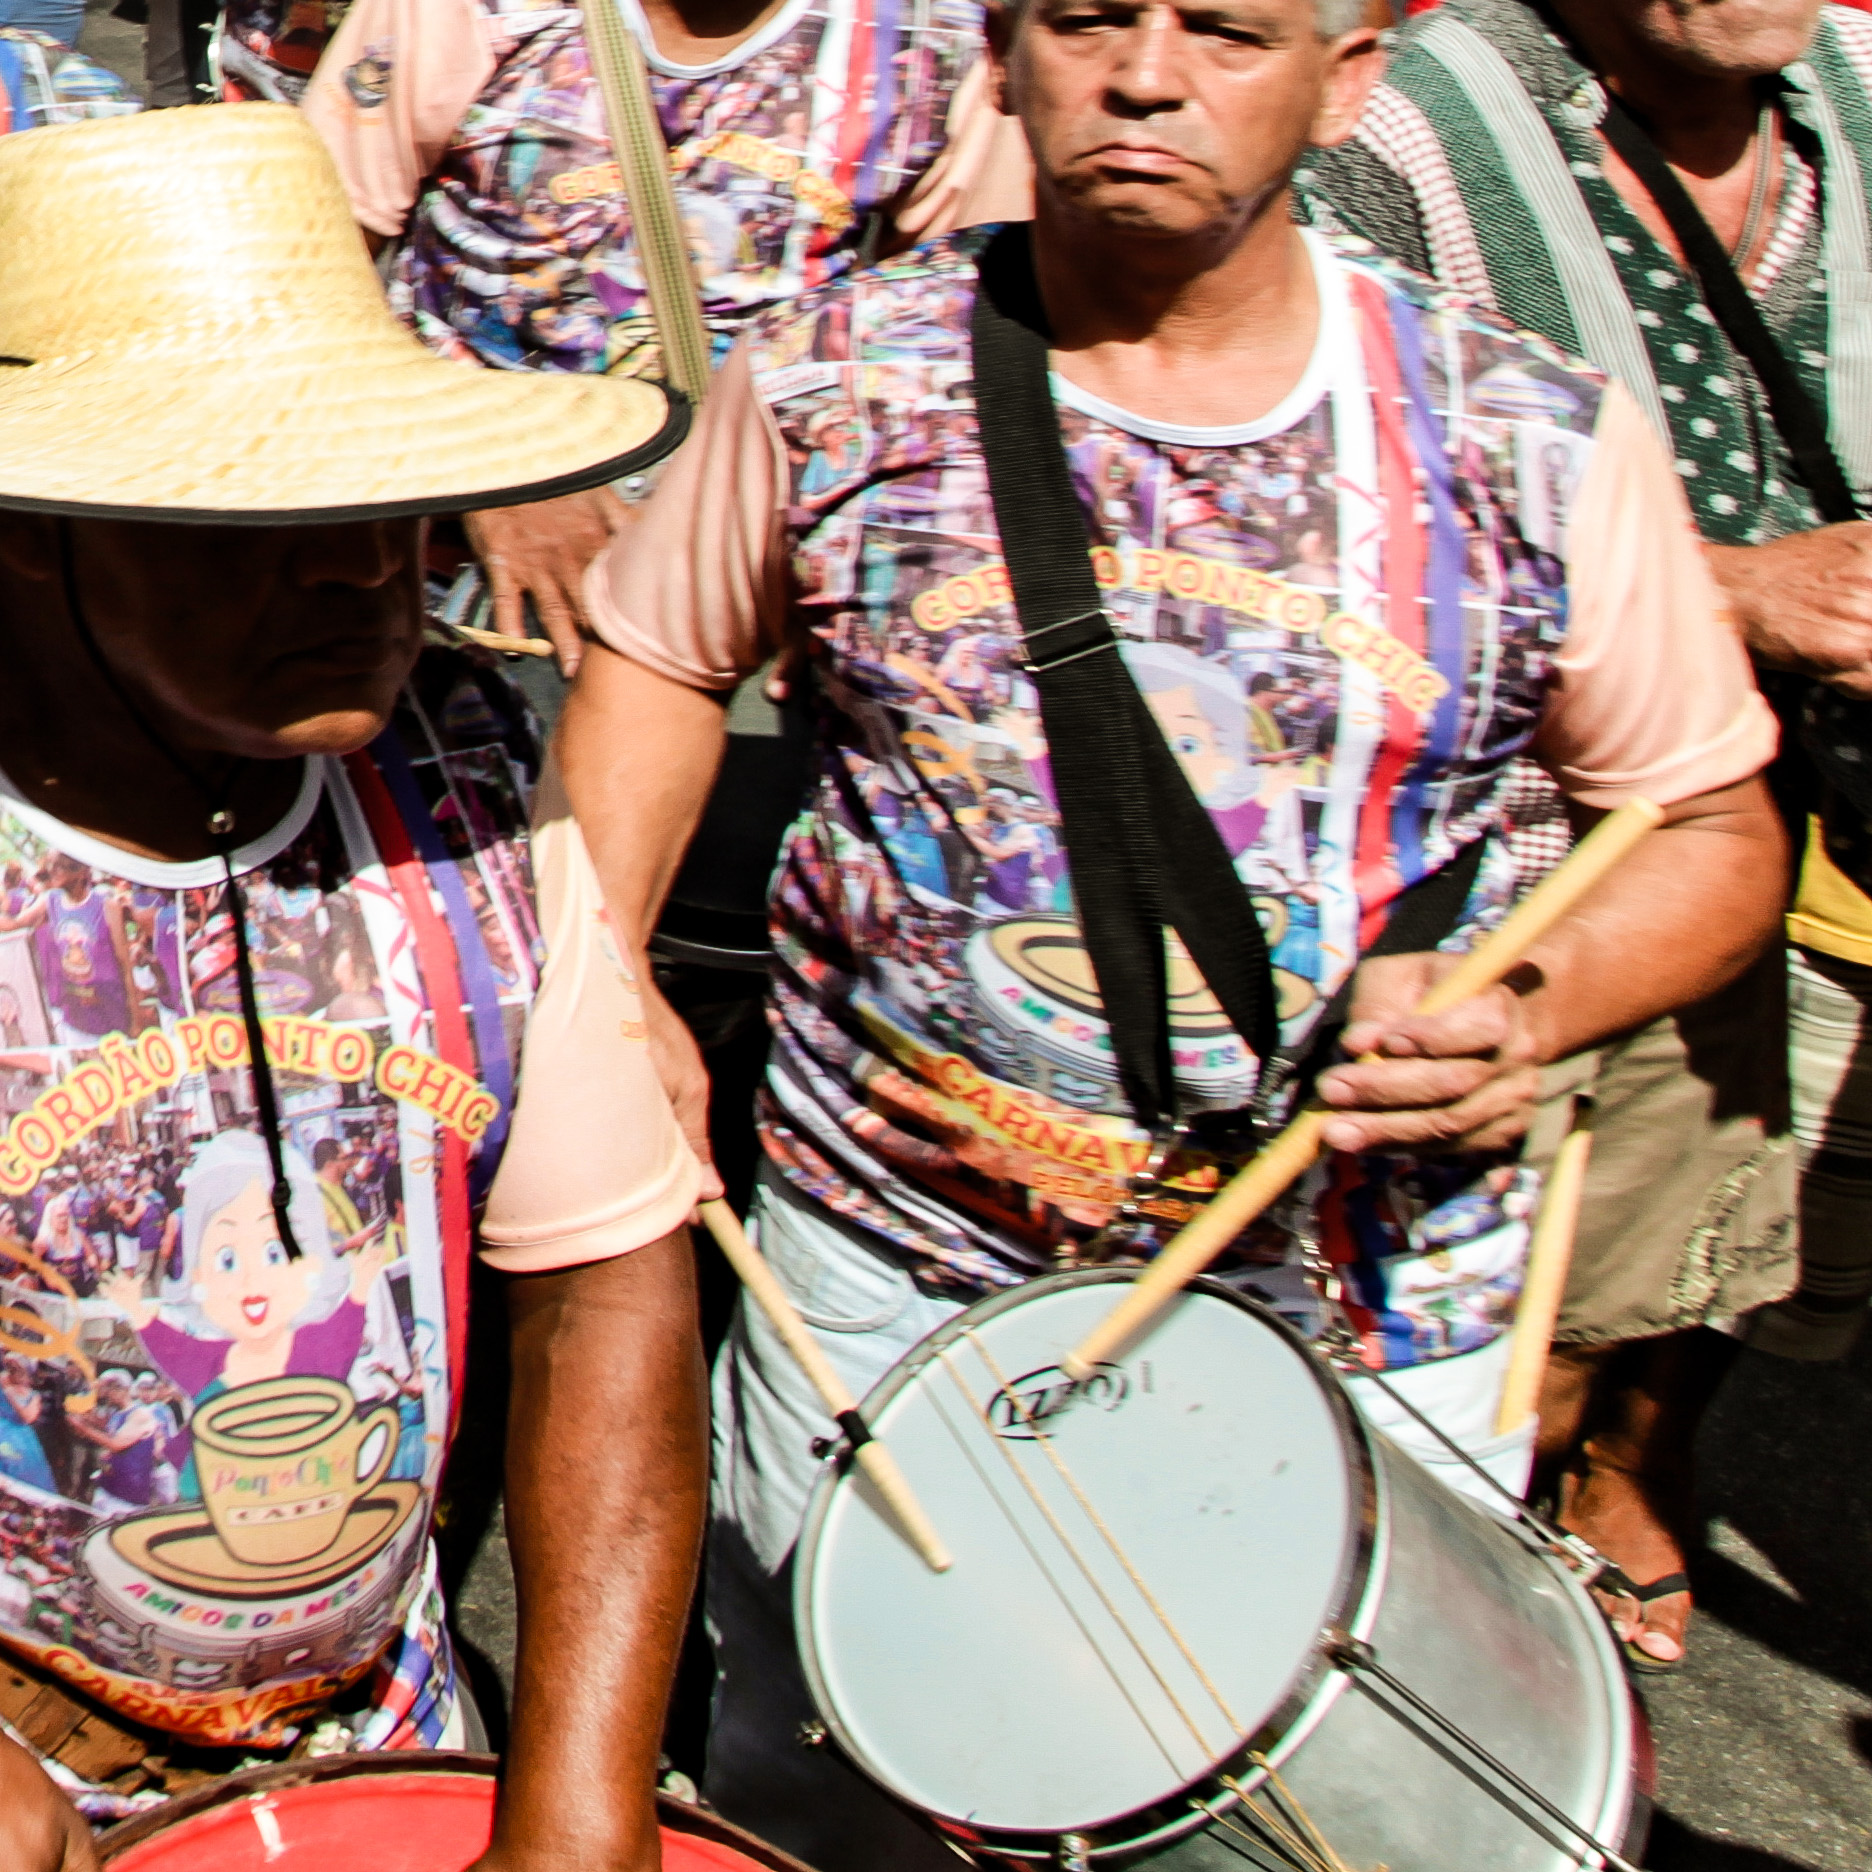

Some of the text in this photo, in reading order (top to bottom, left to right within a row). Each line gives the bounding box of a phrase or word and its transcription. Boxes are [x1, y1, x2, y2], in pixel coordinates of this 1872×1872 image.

[1137, 553, 1318, 626] PONTO
[1330, 616, 1443, 707] CHIC
[178, 1018, 368, 1080] PONTO
[379, 1048, 498, 1139] CHIC
[123, 1582, 246, 1629] AMIGOS
[253, 1610, 297, 1629] DA
